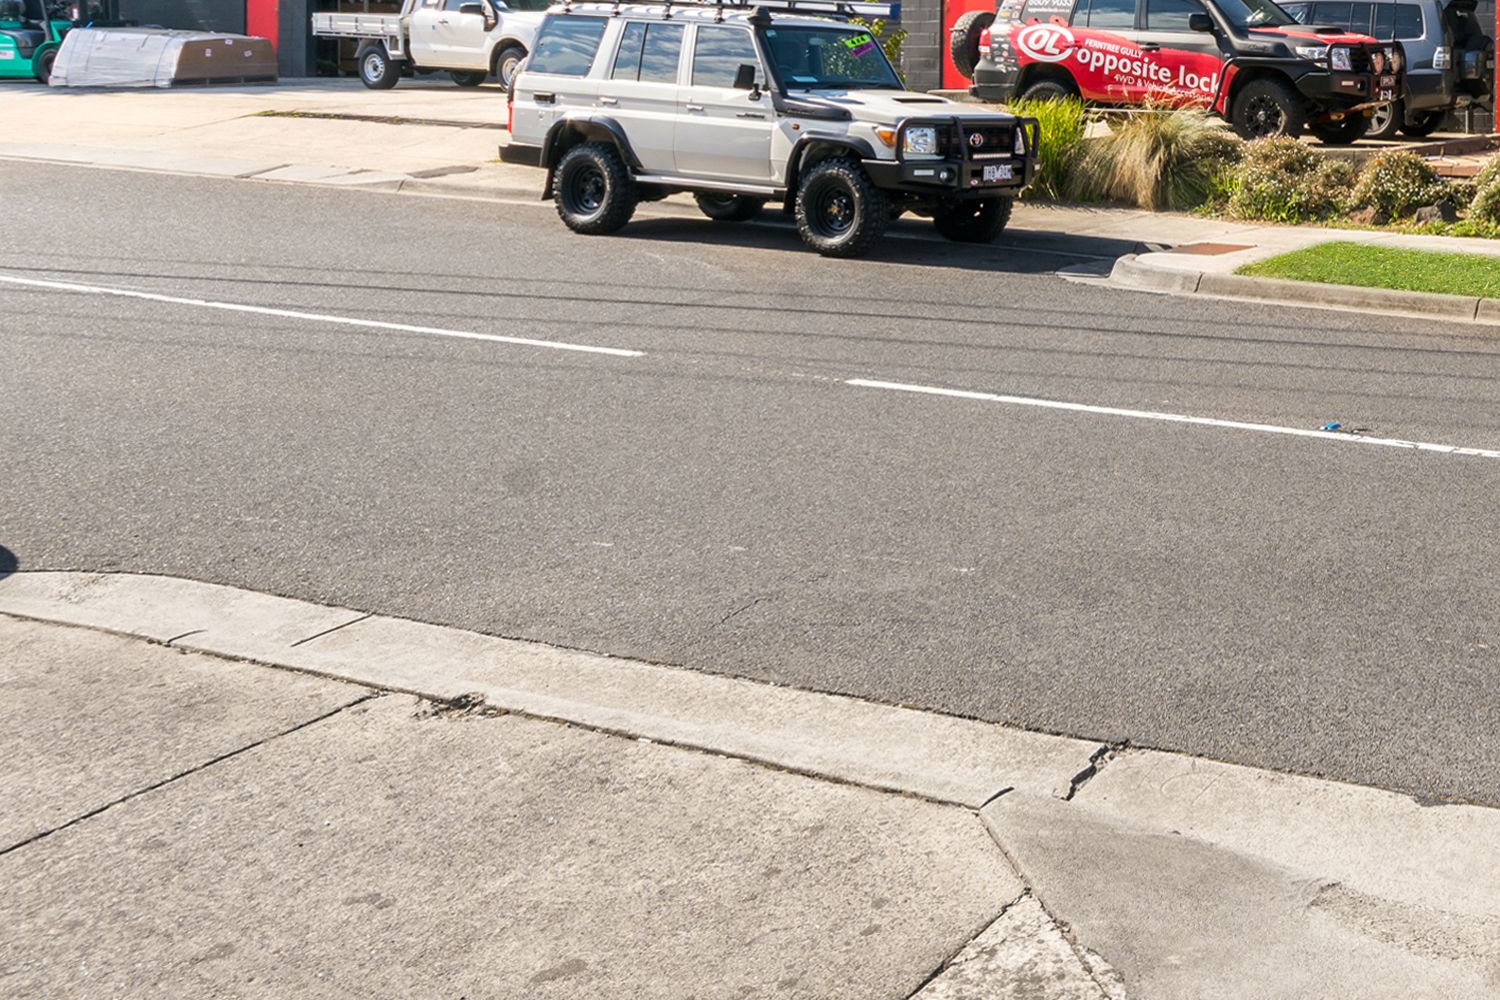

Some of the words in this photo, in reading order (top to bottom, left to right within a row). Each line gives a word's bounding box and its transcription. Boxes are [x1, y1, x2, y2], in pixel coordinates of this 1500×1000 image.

[1027, 29, 1060, 55] OL
[1084, 38, 1121, 55] FERNTREE
[1120, 45, 1144, 59] GULLY
[1076, 48, 1171, 83] opposite
[1178, 64, 1220, 94] lock
